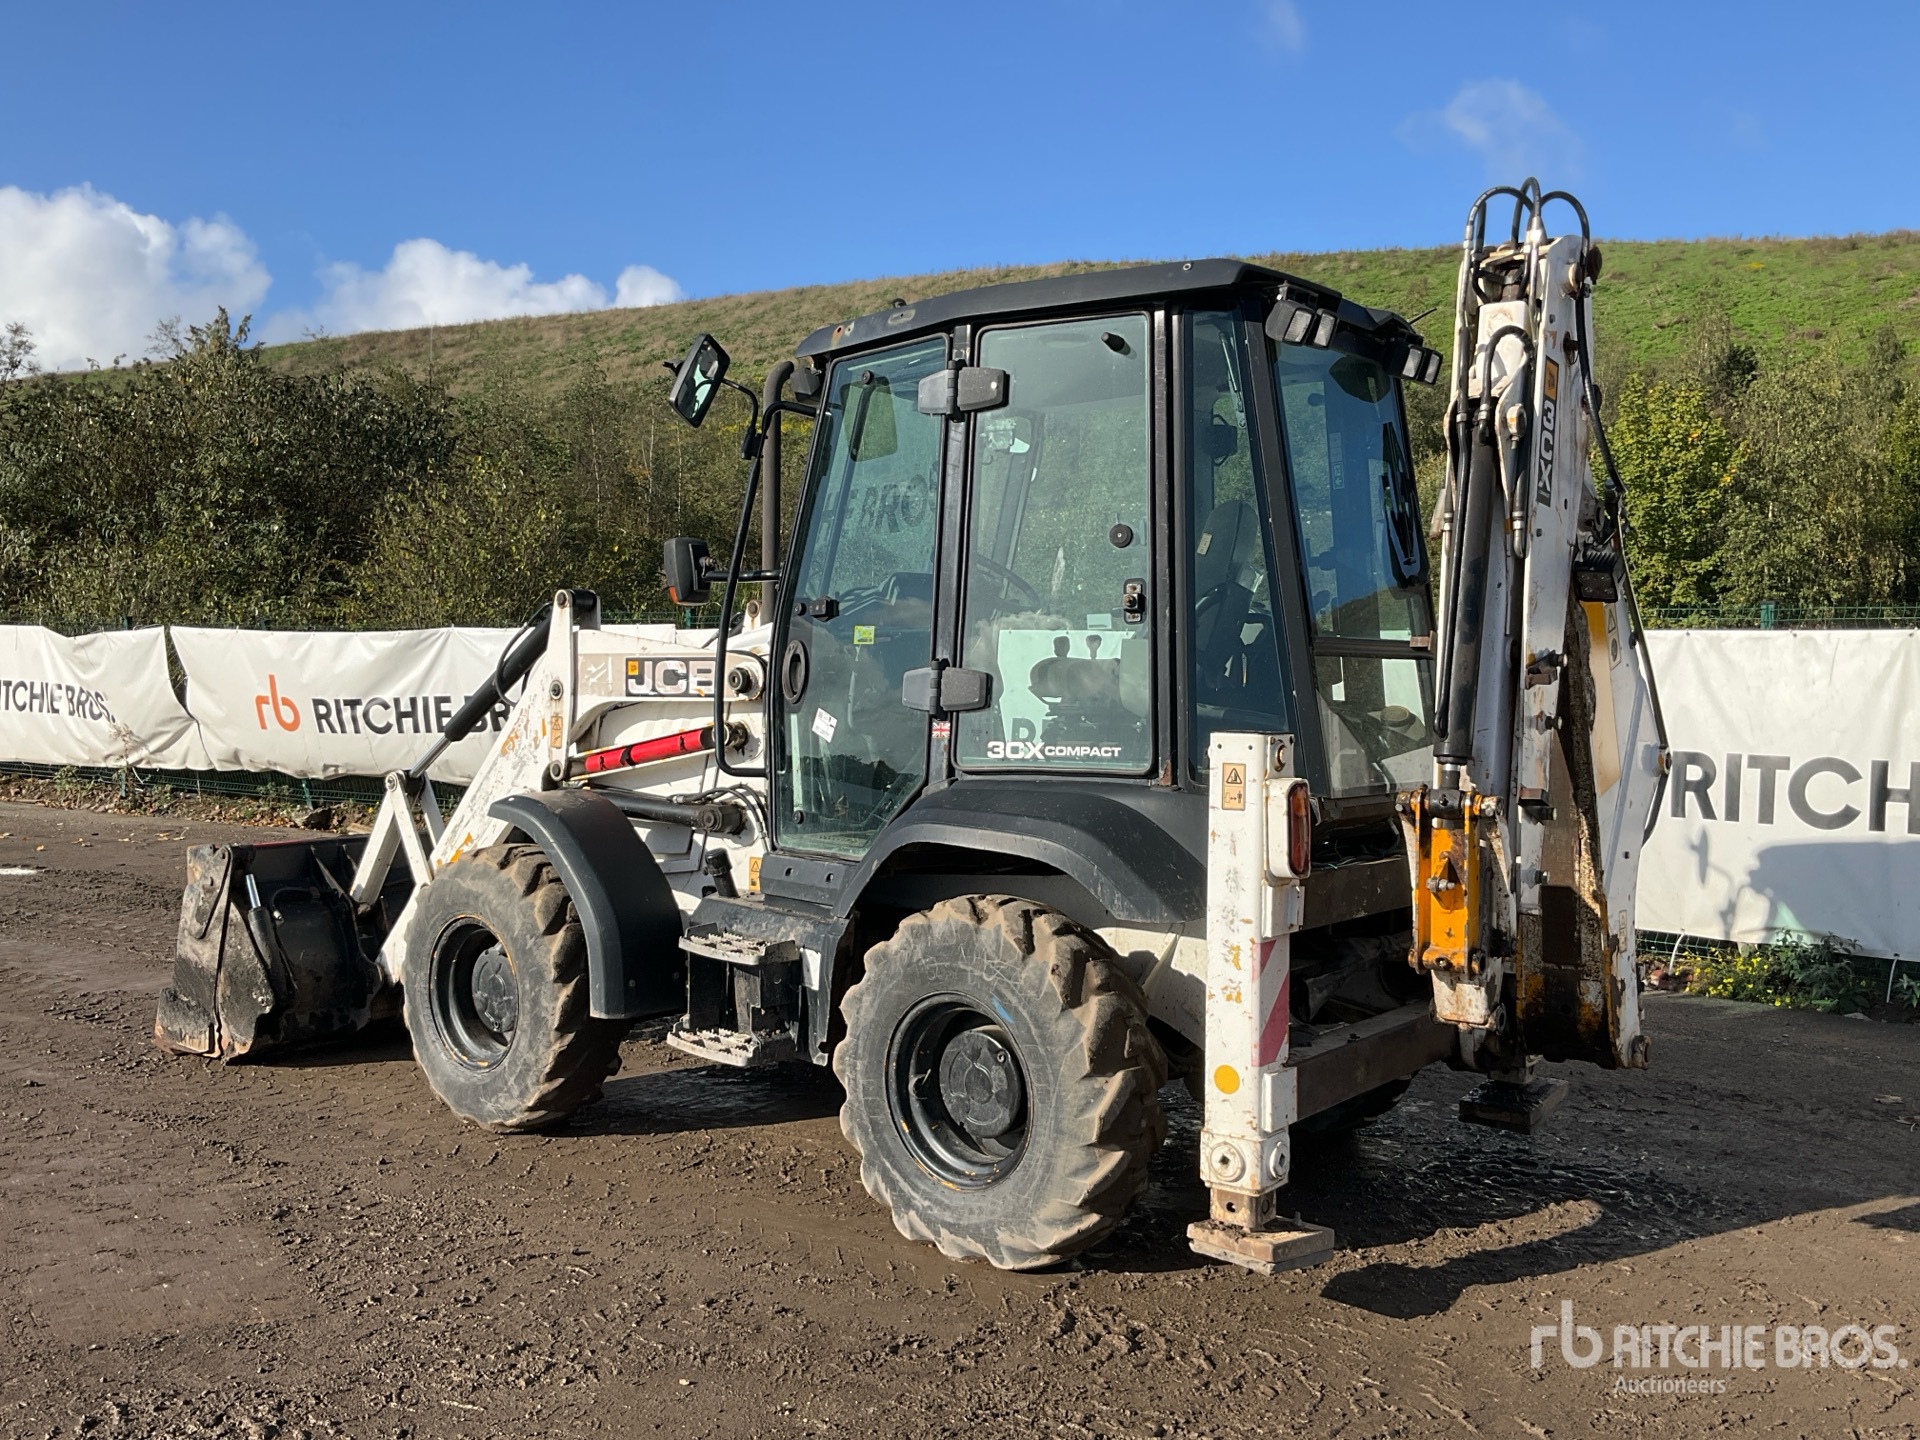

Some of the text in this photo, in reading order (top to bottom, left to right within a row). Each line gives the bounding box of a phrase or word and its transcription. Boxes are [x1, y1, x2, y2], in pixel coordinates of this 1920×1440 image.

[1538, 399, 1555, 492] 3CX
[627, 660, 716, 695] JCB
[255, 674, 300, 732] rb
[311, 696, 452, 734] RITCHIE
[987, 741, 1121, 759] 3CX COMPACT
